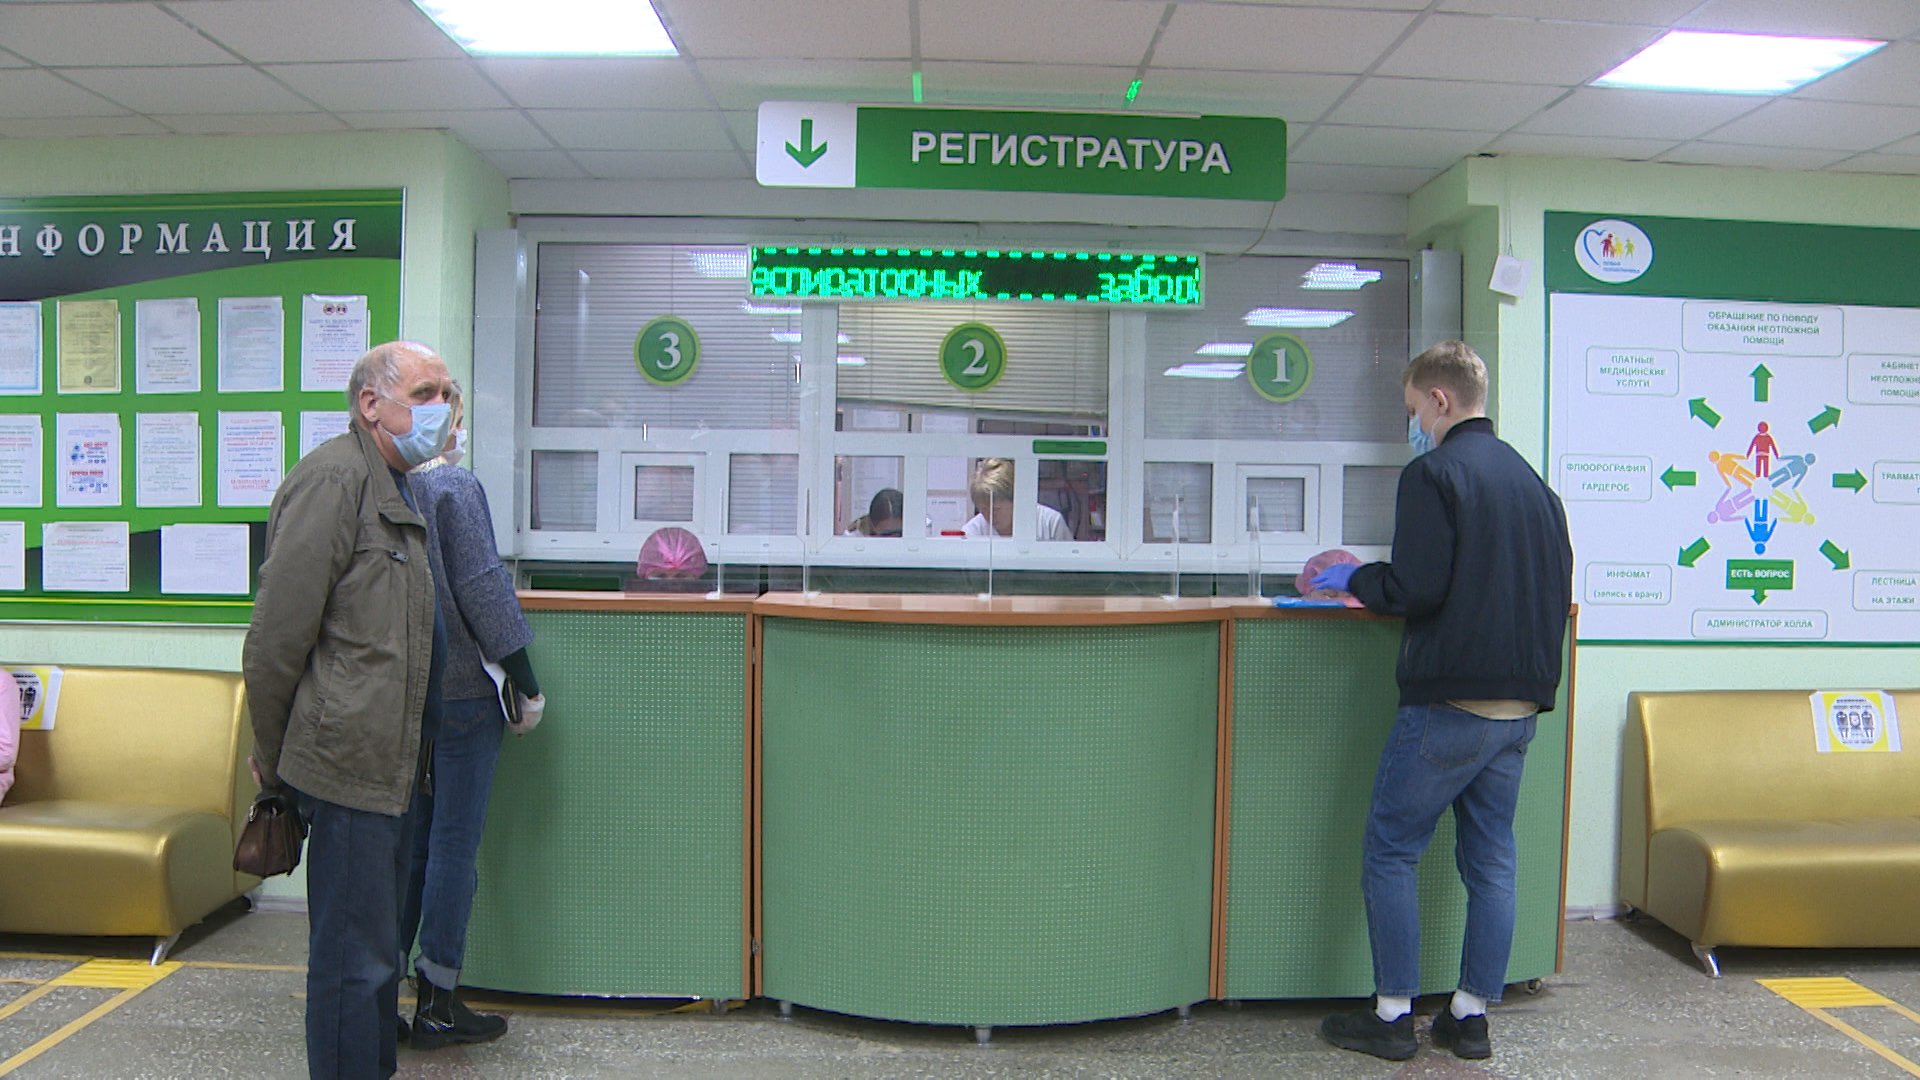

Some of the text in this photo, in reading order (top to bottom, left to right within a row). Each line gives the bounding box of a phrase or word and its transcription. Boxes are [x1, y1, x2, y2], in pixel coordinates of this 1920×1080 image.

[910, 129, 1233, 175] РЕГИСТРАТУРА
[1708, 311, 1819, 324] ОБРАЩЕНИЕ ПО ПОВОДУ
[1707, 323, 1820, 335] ОКАЗАНИЯ НЕОТЛОЖНОЙ
[1743, 336, 1784, 345] ПОМОЩИ
[656, 331, 681, 370] 3
[962, 339, 989, 375] 2
[1611, 355, 1654, 364] ПЛАТНЫЕ
[1271, 348, 1291, 383] 1
[1881, 361, 1919, 370] КАБИНЕТ
[1600, 367, 1666, 376] МЕДИЦИНСКИЕ
[1616, 379, 1650, 388] УСЛУГИ
[1567, 463, 1646, 472] ФЛЮОРОГРАФИЯ
[1881, 472, 1920, 480] ТРАВМАТ
[1582, 483, 1630, 492] ГАРДЕРОБ
[1731, 569, 1790, 578] ЕСТЬ ВОПРОС
[1872, 577, 1917, 586] ЛЕСТНИЦА
[1707, 619, 1813, 628] АДМИНИСТРАТОР ХОЛЛА
